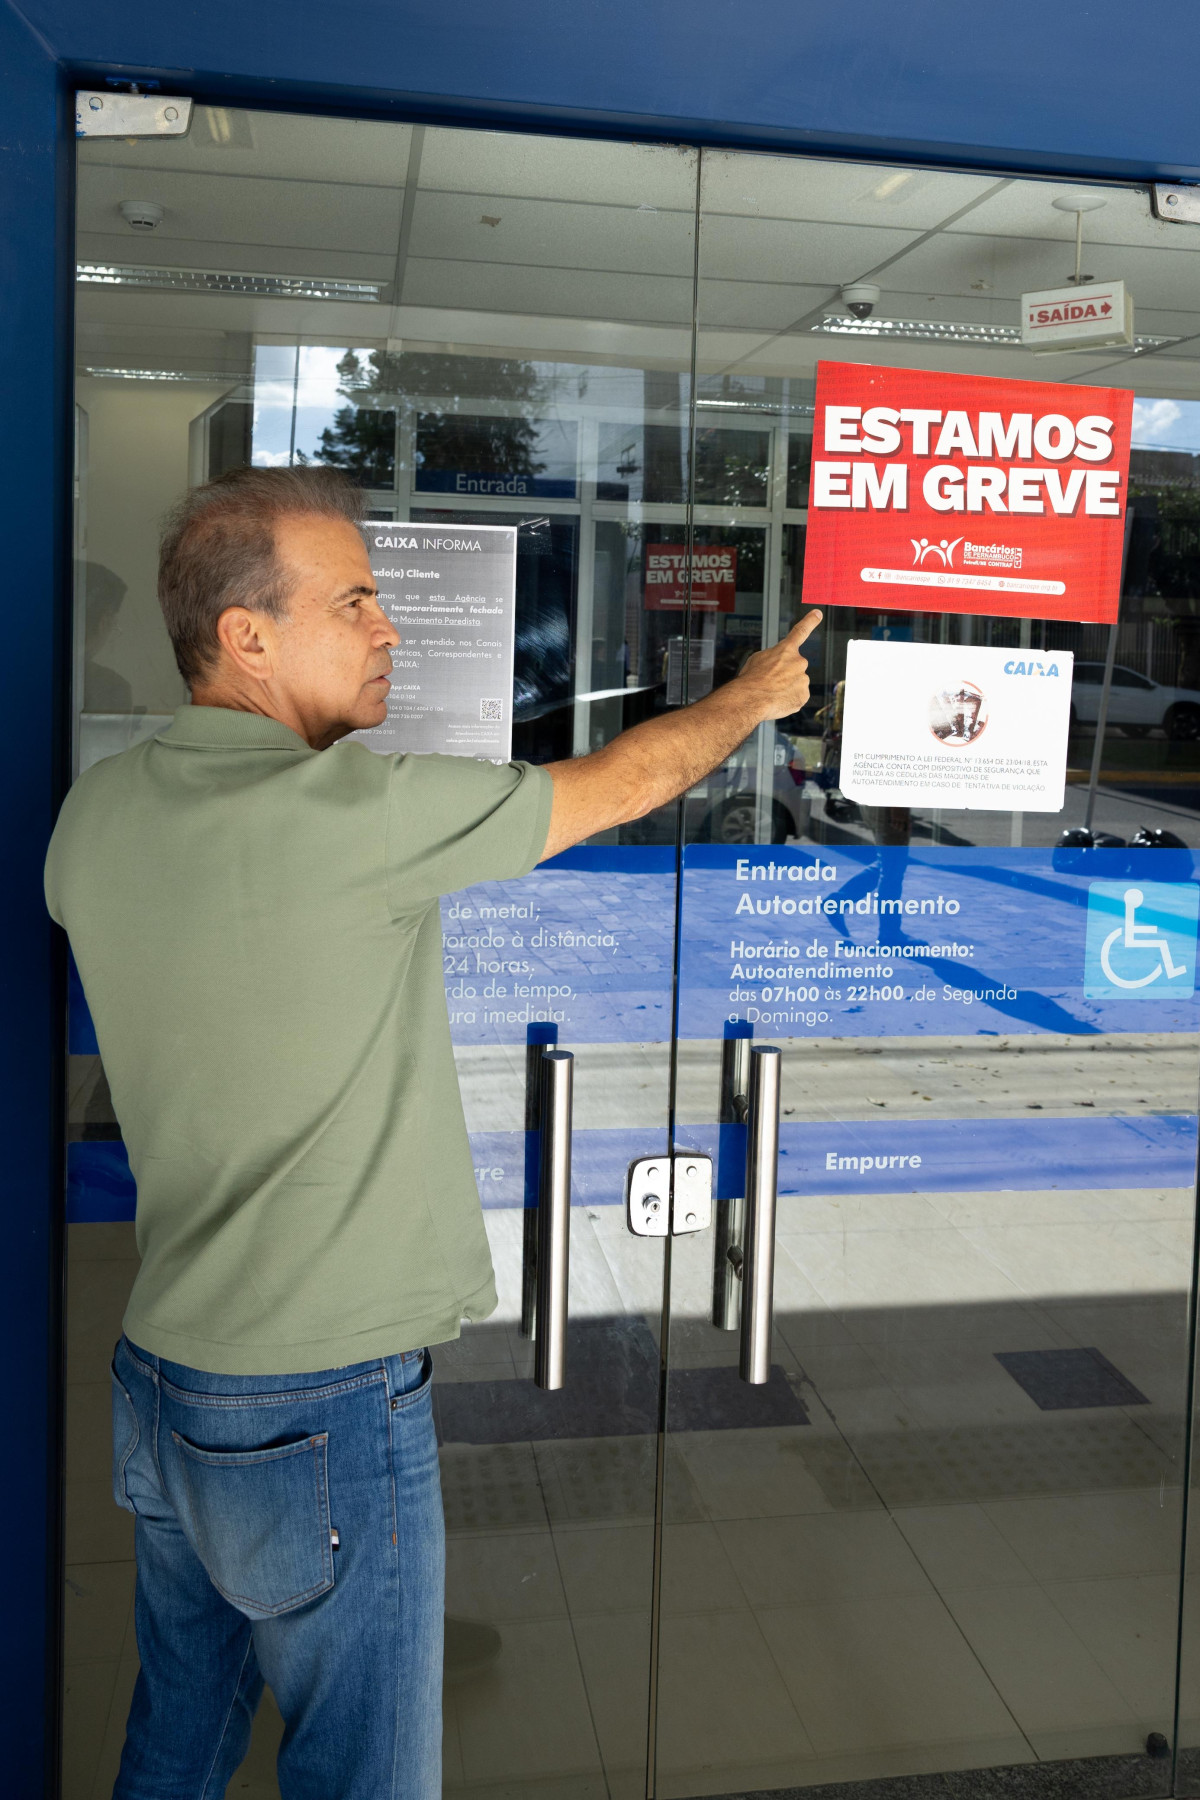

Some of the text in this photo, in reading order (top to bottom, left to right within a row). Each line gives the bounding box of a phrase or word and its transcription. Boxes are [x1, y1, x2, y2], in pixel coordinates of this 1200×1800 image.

[1037, 304, 1097, 323] SAÍDA
[824, 405, 1114, 462] ESTAMOS
[456, 473, 527, 494] Entrada
[813, 461, 1120, 515] EM GREVE
[374, 536, 482, 552] CAIXA INFORMA
[964, 541, 1015, 555] Bancários
[649, 554, 732, 569] ESTAMOS
[372, 568, 440, 579] ado(a) Cliente
[646, 569, 734, 584] EM GREVE
[406, 594, 420, 602] que
[455, 594, 486, 603] Agência
[391, 604, 464, 614] temporariamente
[470, 605, 504, 614] fechada
[400, 616, 442, 625] Movimento
[421, 638, 456, 646] atendido
[476, 640, 502, 648] Canais
[390, 648, 422, 658] otéricas,
[428, 649, 492, 659] Correspondentes
[392, 660, 420, 668] CAIXA:
[1003, 660, 1060, 677] CAIXA
[854, 752, 864, 760] EM
[865, 753, 916, 762] CUMPRIMENTO
[934, 756, 962, 764] FEDERAL
[886, 762, 911, 770] CONTA
[930, 764, 972, 773] DISPOSITIVO
[984, 766, 1024, 776] SEGURANÇA
[1026, 768, 1040, 776] QUE
[852, 778, 919, 787] AUTOATENDIMENTO
[920, 780, 930, 788] EM
[964, 782, 1000, 790] TENTATIVA
[735, 859, 837, 881] Entrada
[448, 901, 541, 921] de metal;
[735, 893, 961, 915] Autoatendimento
[442, 927, 620, 955] torado à distância;
[730, 939, 975, 959] Horário de Funcionamento:
[443, 955, 469, 974] 24
[730, 962, 894, 980] Autoatendimento
[445, 978, 577, 1003] rdo de tempo,
[729, 985, 757, 1002] das
[761, 986, 820, 1003] 07h00
[824, 986, 842, 1001] às
[846, 985, 904, 1001] 22h00
[942, 984, 1018, 1005] Segunda
[484, 1002, 571, 1023] imediata.
[728, 1007, 834, 1027] a Domingo.
[825, 1152, 922, 1174] Empurre
